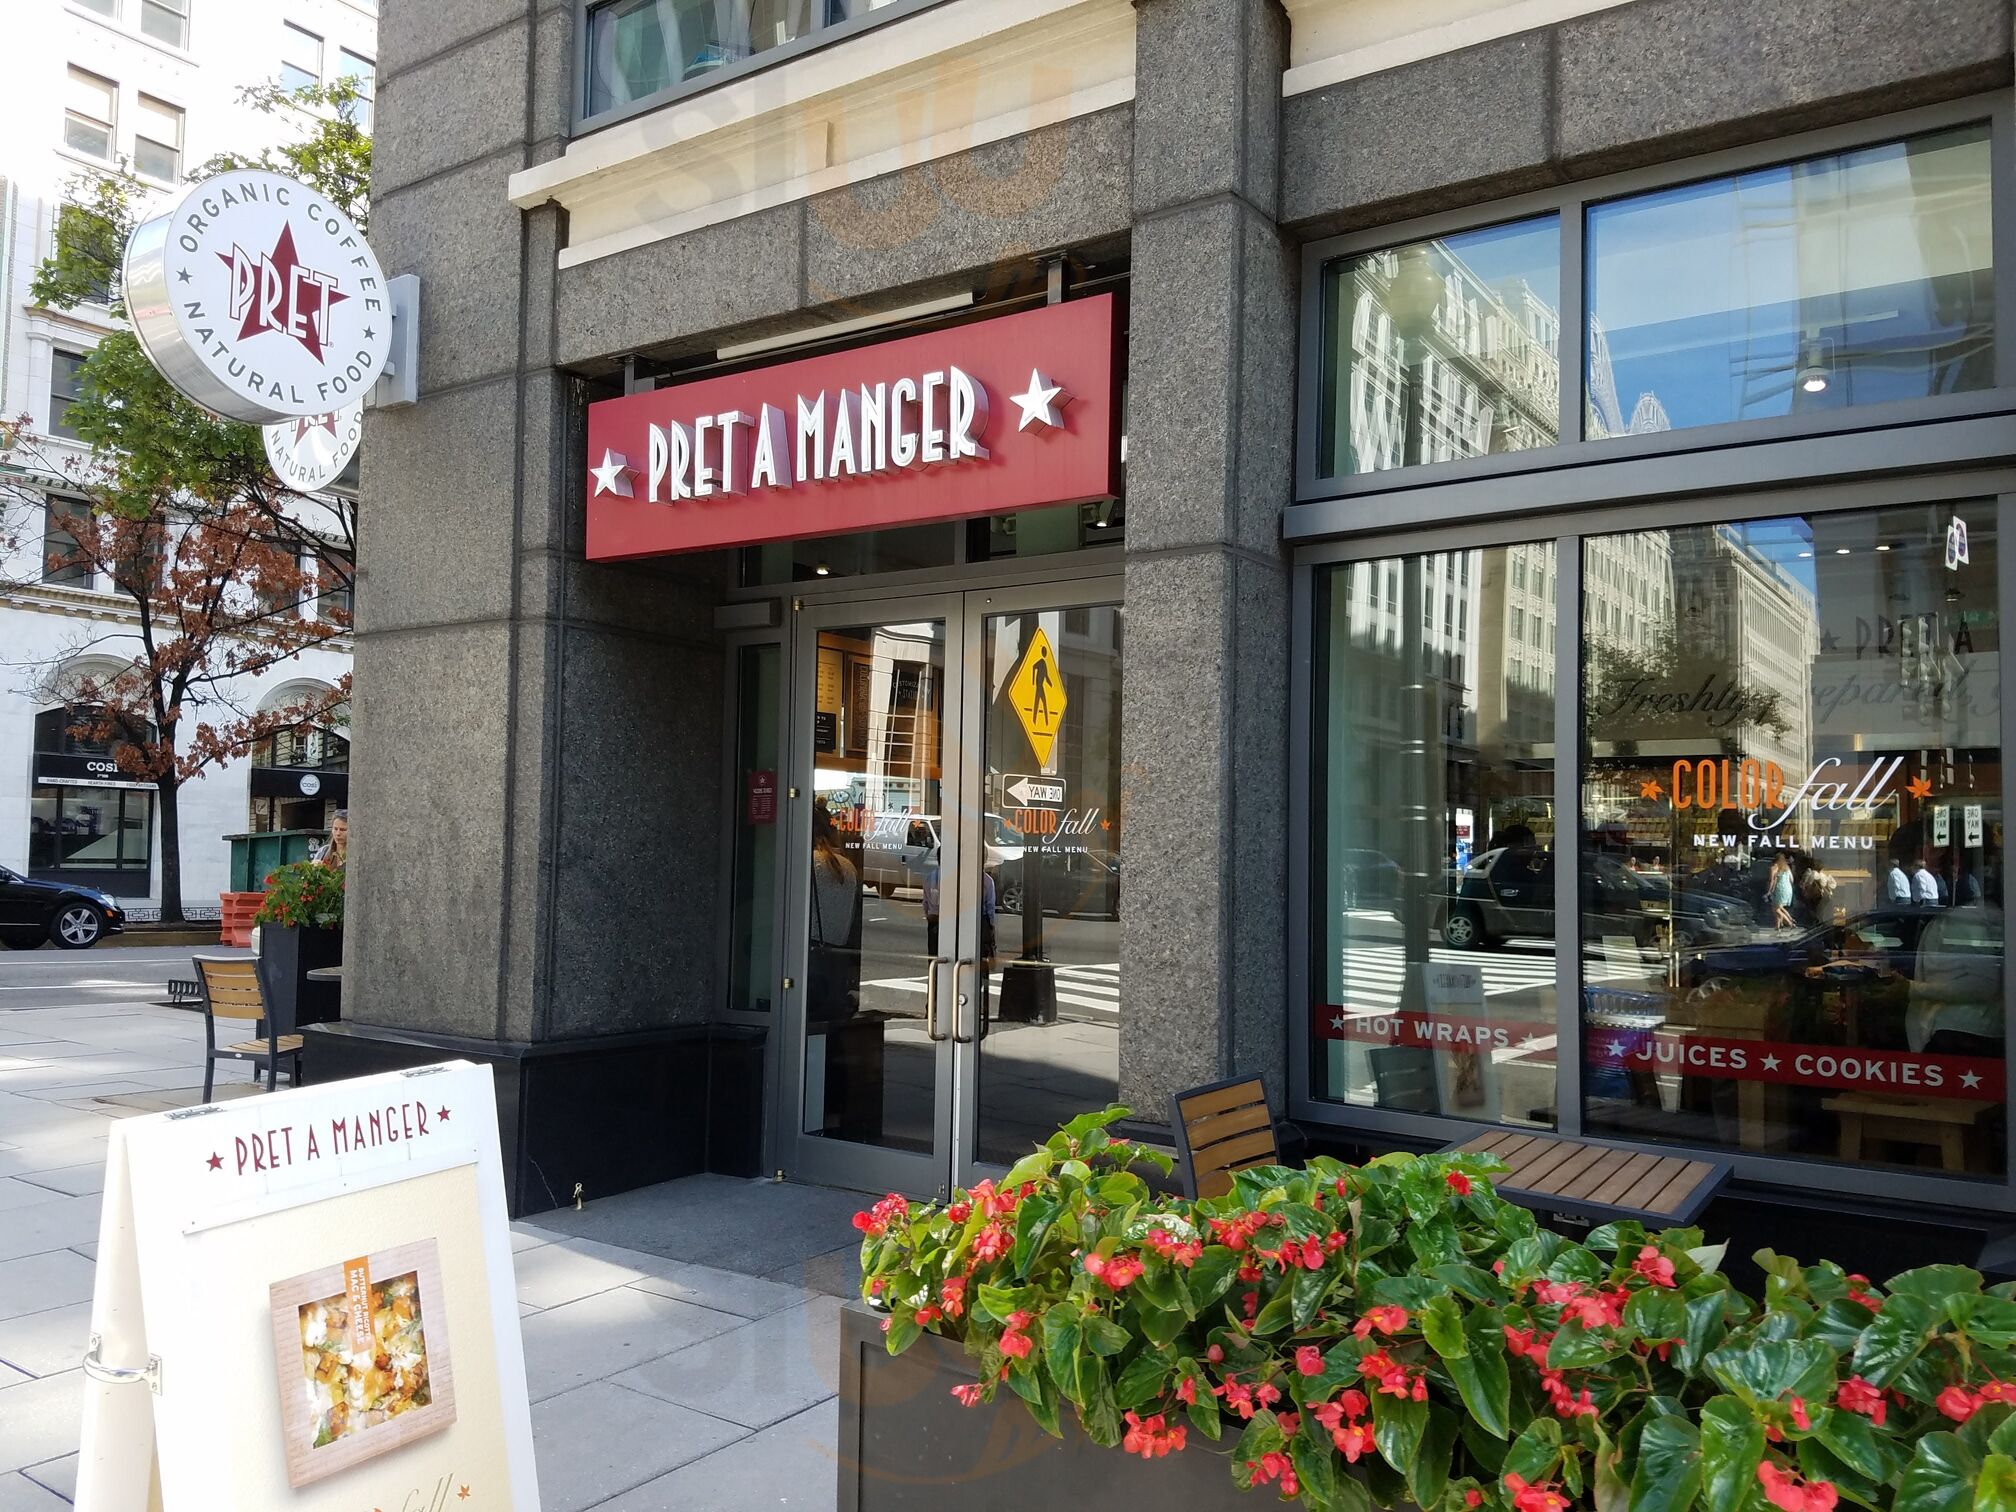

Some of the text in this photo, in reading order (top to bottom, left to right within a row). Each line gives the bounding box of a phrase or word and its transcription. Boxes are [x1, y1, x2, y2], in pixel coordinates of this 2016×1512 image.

[179, 182, 382, 313] ORGANIC COFFEE
[229, 241, 340, 348] PRET
[184, 301, 373, 404] NATURAL FOOD
[271, 430, 326, 482] NATURAL
[332, 411, 363, 468] FOOD
[649, 365, 984, 504] PRET A MANGER
[1015, 808, 1100, 844] COLOR fall
[1673, 757, 1905, 830] COLOR fall
[1693, 834, 1874, 850] NEW FALL MENU
[1356, 1016, 1510, 1050] HOT WRAPS
[1635, 1042, 1944, 1089] JUICES COOKIES
[235, 1101, 430, 1176] PRET A MANGER
[349, 1269, 360, 1293] MAC
[353, 1304, 366, 1345] CHEESE
